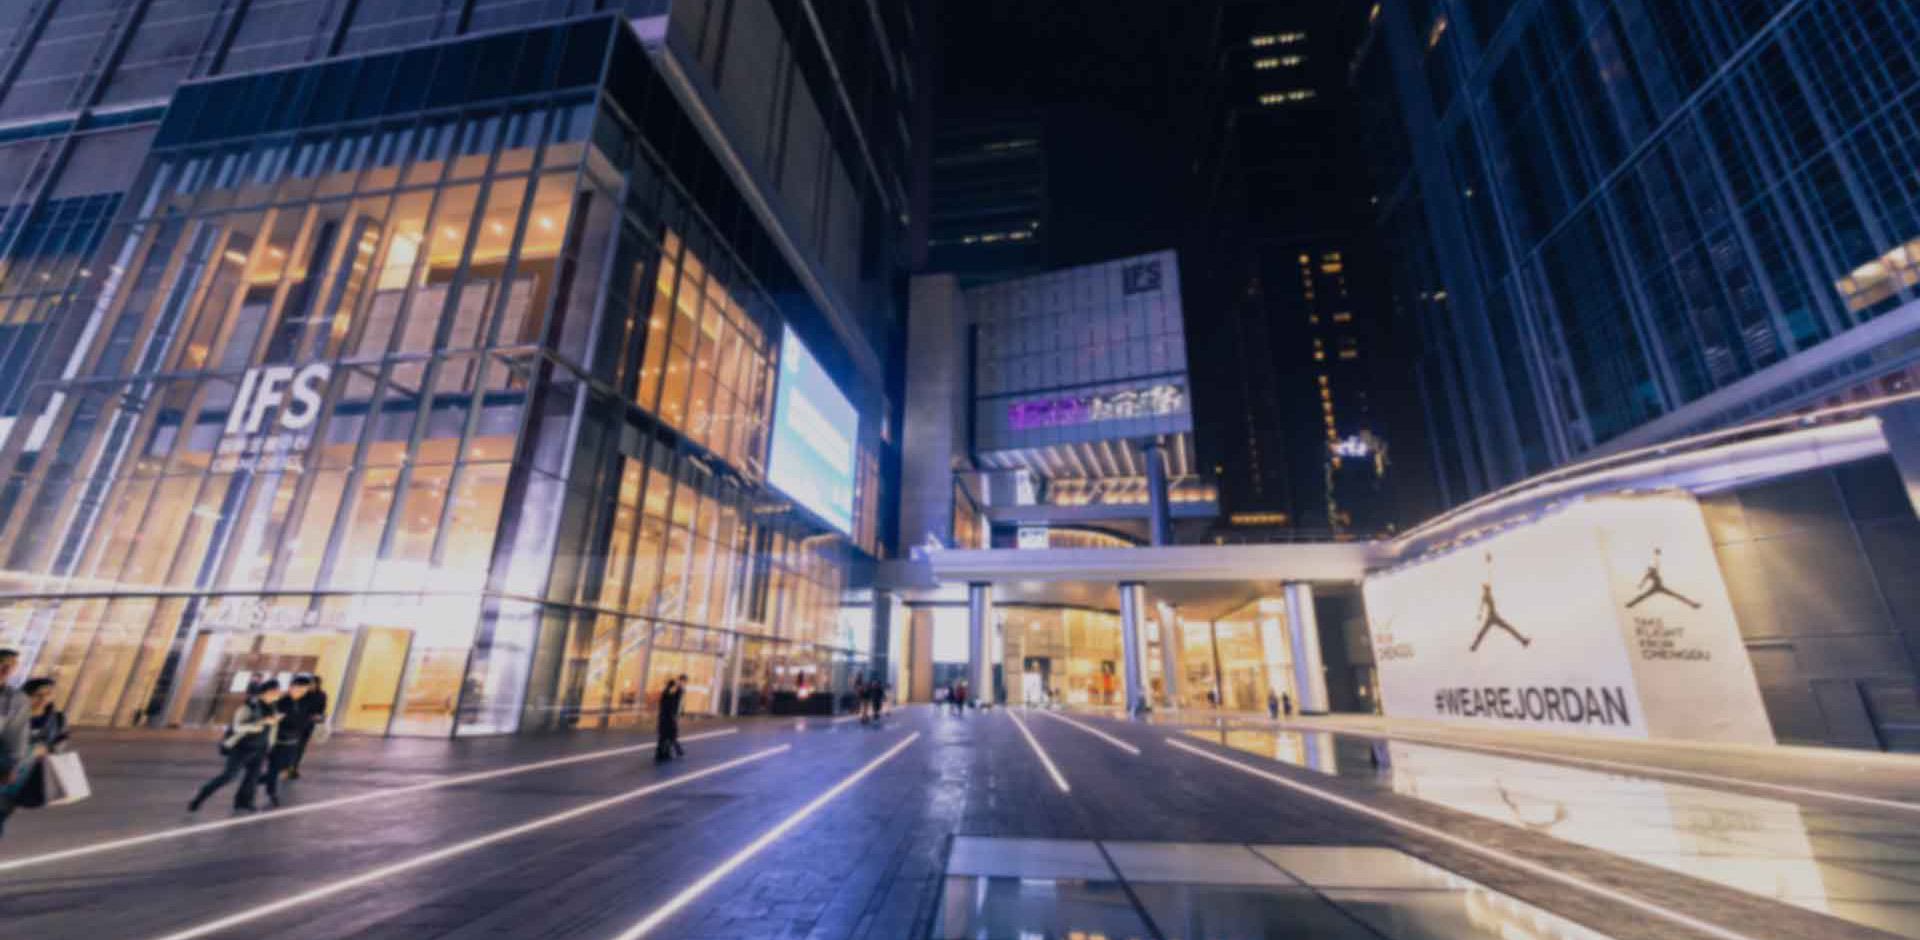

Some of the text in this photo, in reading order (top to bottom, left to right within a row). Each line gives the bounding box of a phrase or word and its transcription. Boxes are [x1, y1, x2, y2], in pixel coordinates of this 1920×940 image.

[1123, 262, 1162, 294] IFS
[225, 364, 332, 433] IFS
[1435, 686, 1631, 726] #WEAREJORDAN
